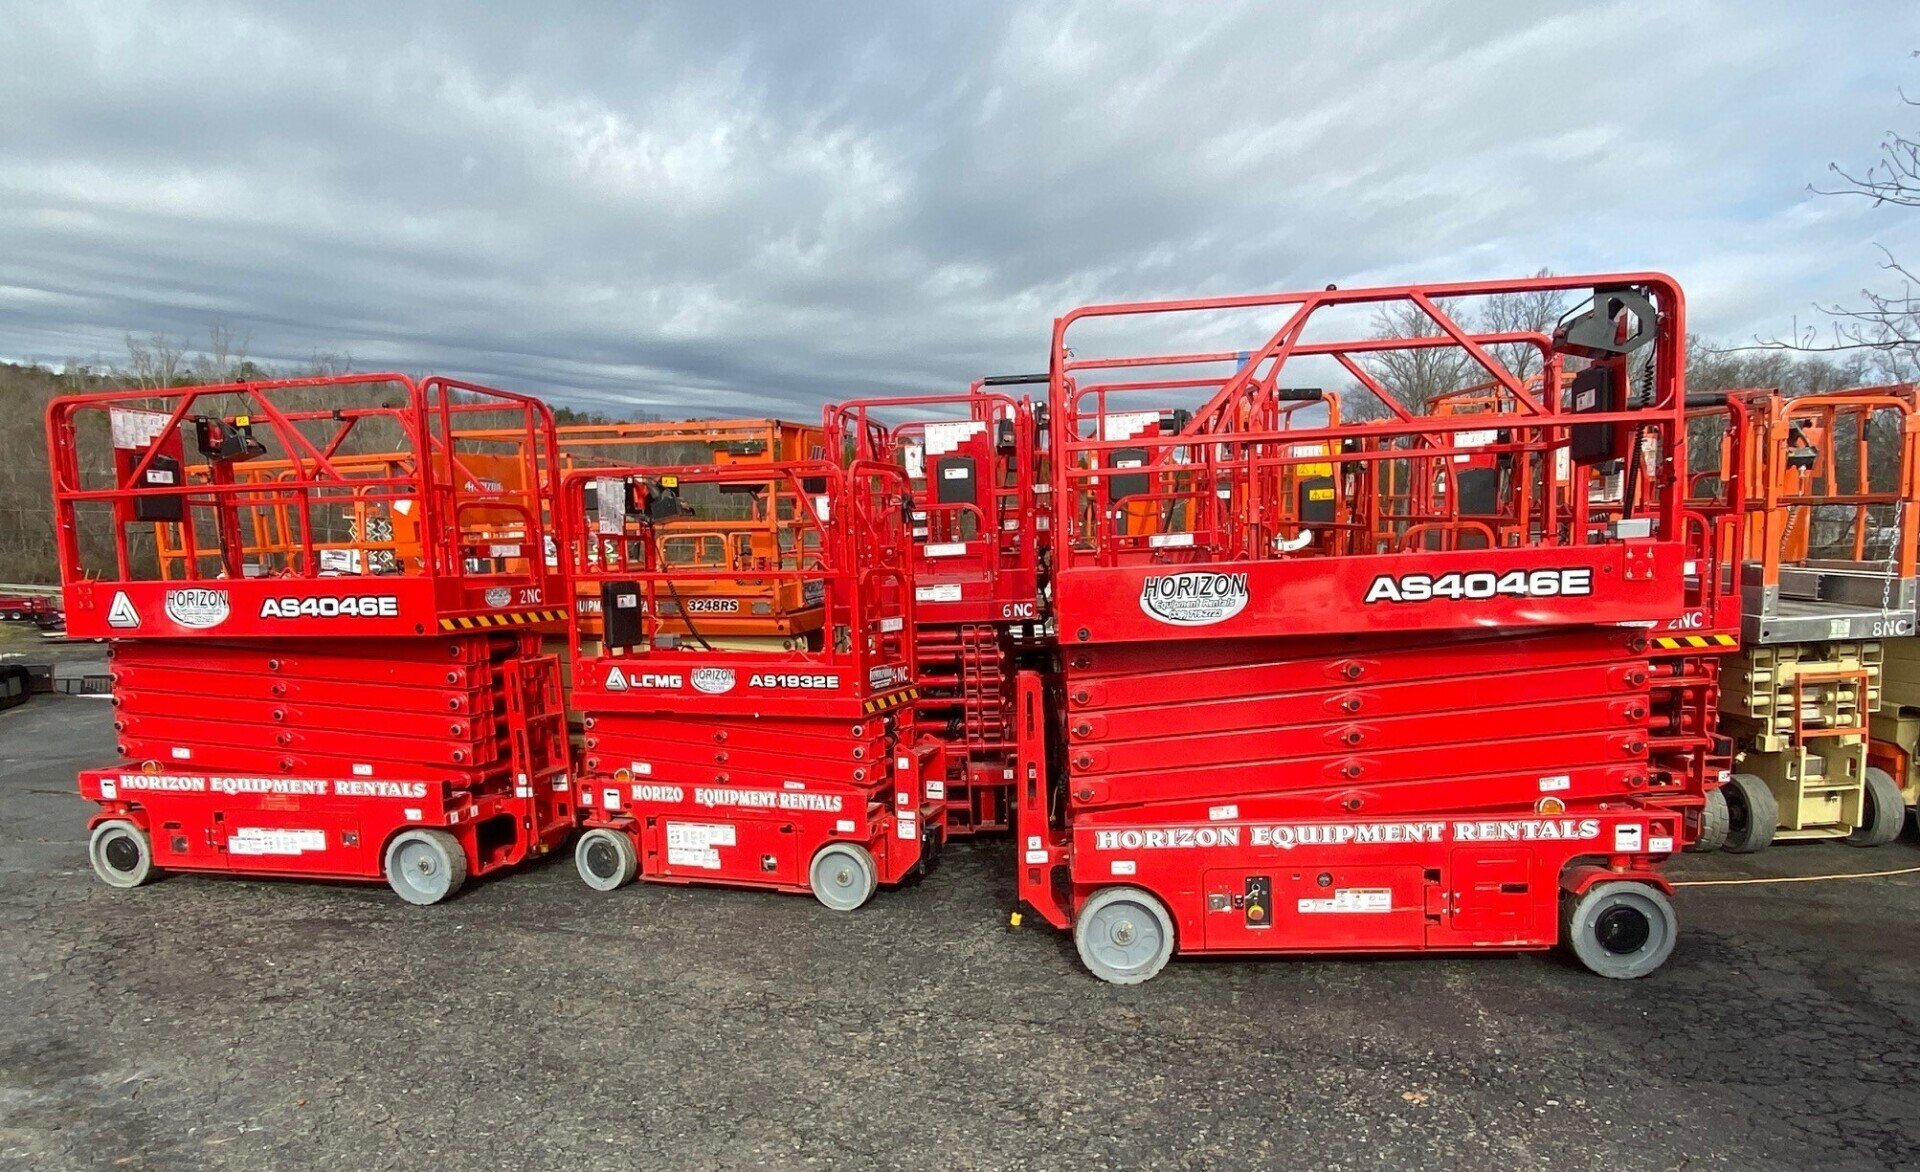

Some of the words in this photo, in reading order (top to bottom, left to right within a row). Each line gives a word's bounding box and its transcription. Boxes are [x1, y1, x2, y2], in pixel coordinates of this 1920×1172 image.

[1143, 574, 1247, 599] HORIZON
[1364, 568, 1592, 603] AS4046E
[166, 590, 229, 608] HORIZON
[520, 589, 542, 603] 2NC
[260, 596, 398, 618] AS4046E
[687, 600, 739, 613] 3248RS
[1872, 619, 1907, 636] 8NC
[692, 668, 735, 680] HORIZON
[748, 674, 840, 689] AS1932E
[120, 775, 206, 791] HORIZON
[210, 777, 327, 795] EQUIPMENT
[334, 780, 427, 798] RENTALS
[631, 785, 684, 803] HORIZO
[694, 787, 777, 808] EQUIPMENT
[778, 793, 842, 812] RENTALS
[1096, 827, 1240, 850] HORIZON
[1250, 821, 1447, 850] EQUIPMENT
[1453, 819, 1600, 841] RENTALS
